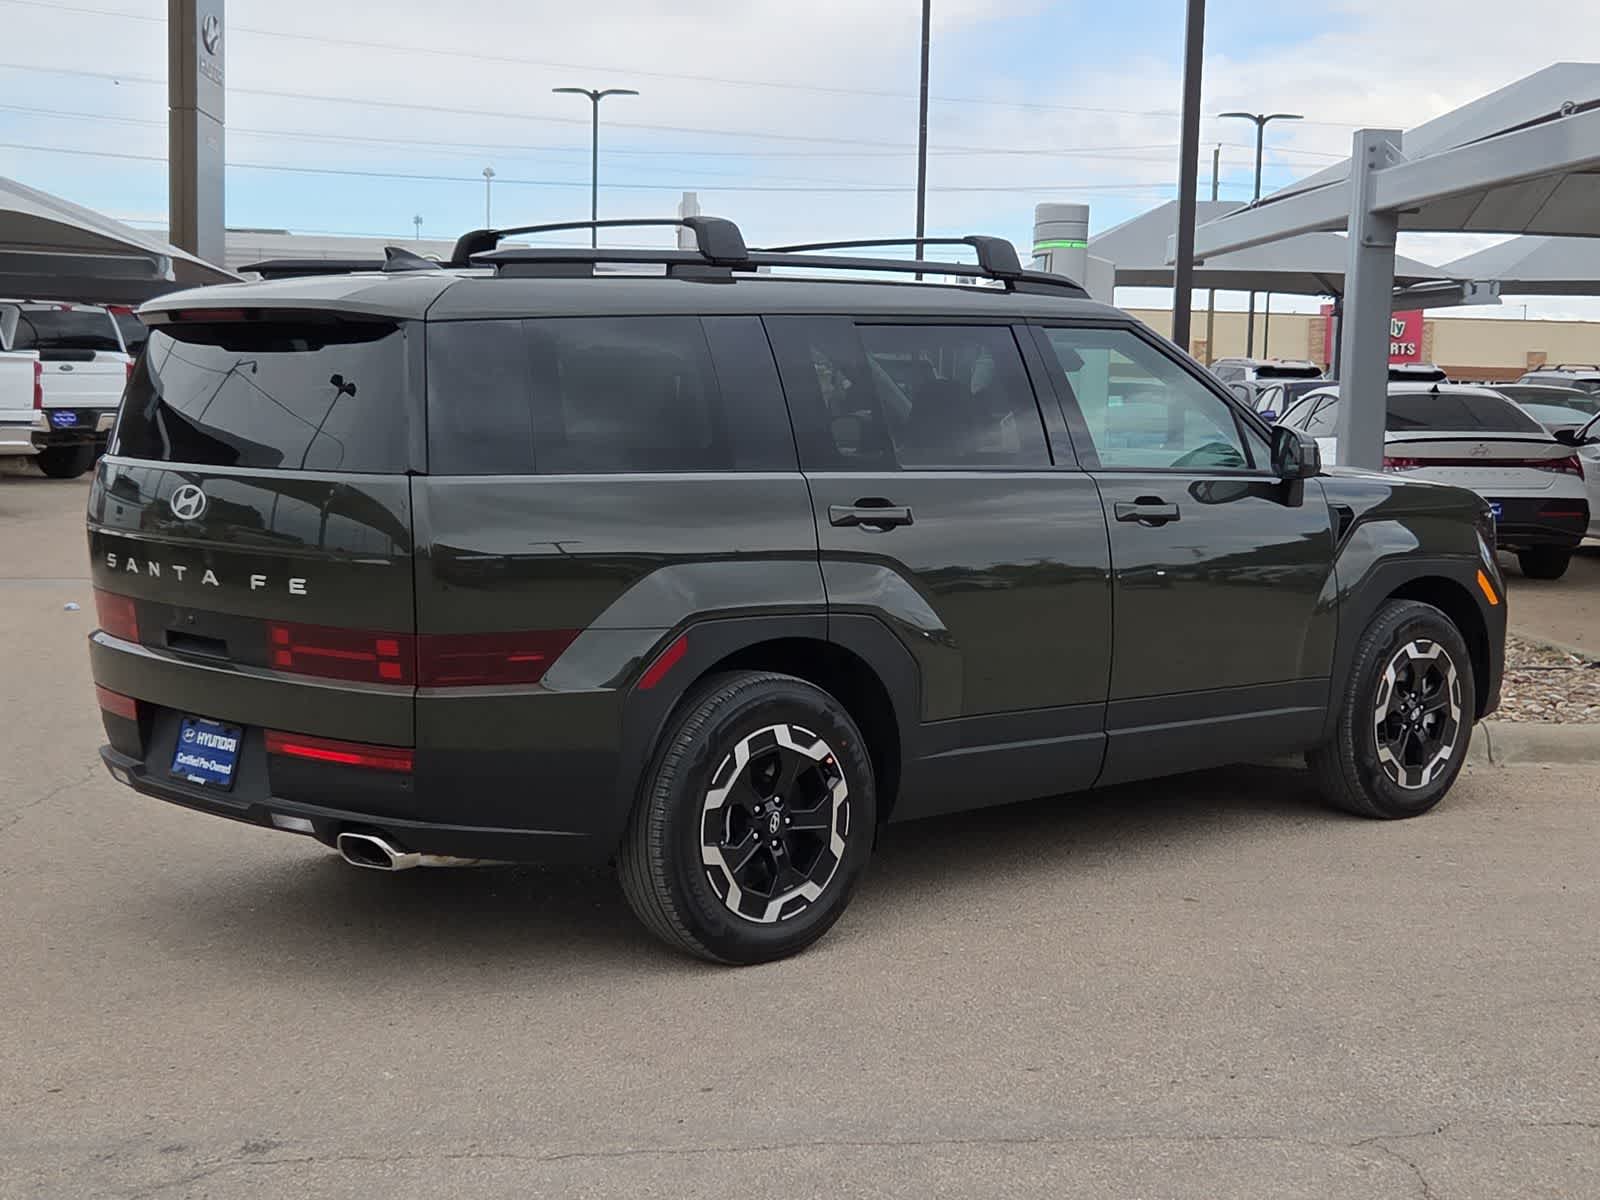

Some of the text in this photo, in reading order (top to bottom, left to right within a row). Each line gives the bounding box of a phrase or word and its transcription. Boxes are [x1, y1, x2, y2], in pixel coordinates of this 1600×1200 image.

[106, 552, 307, 595] SANTA FE
[196, 731, 237, 752] HYUNDAI
